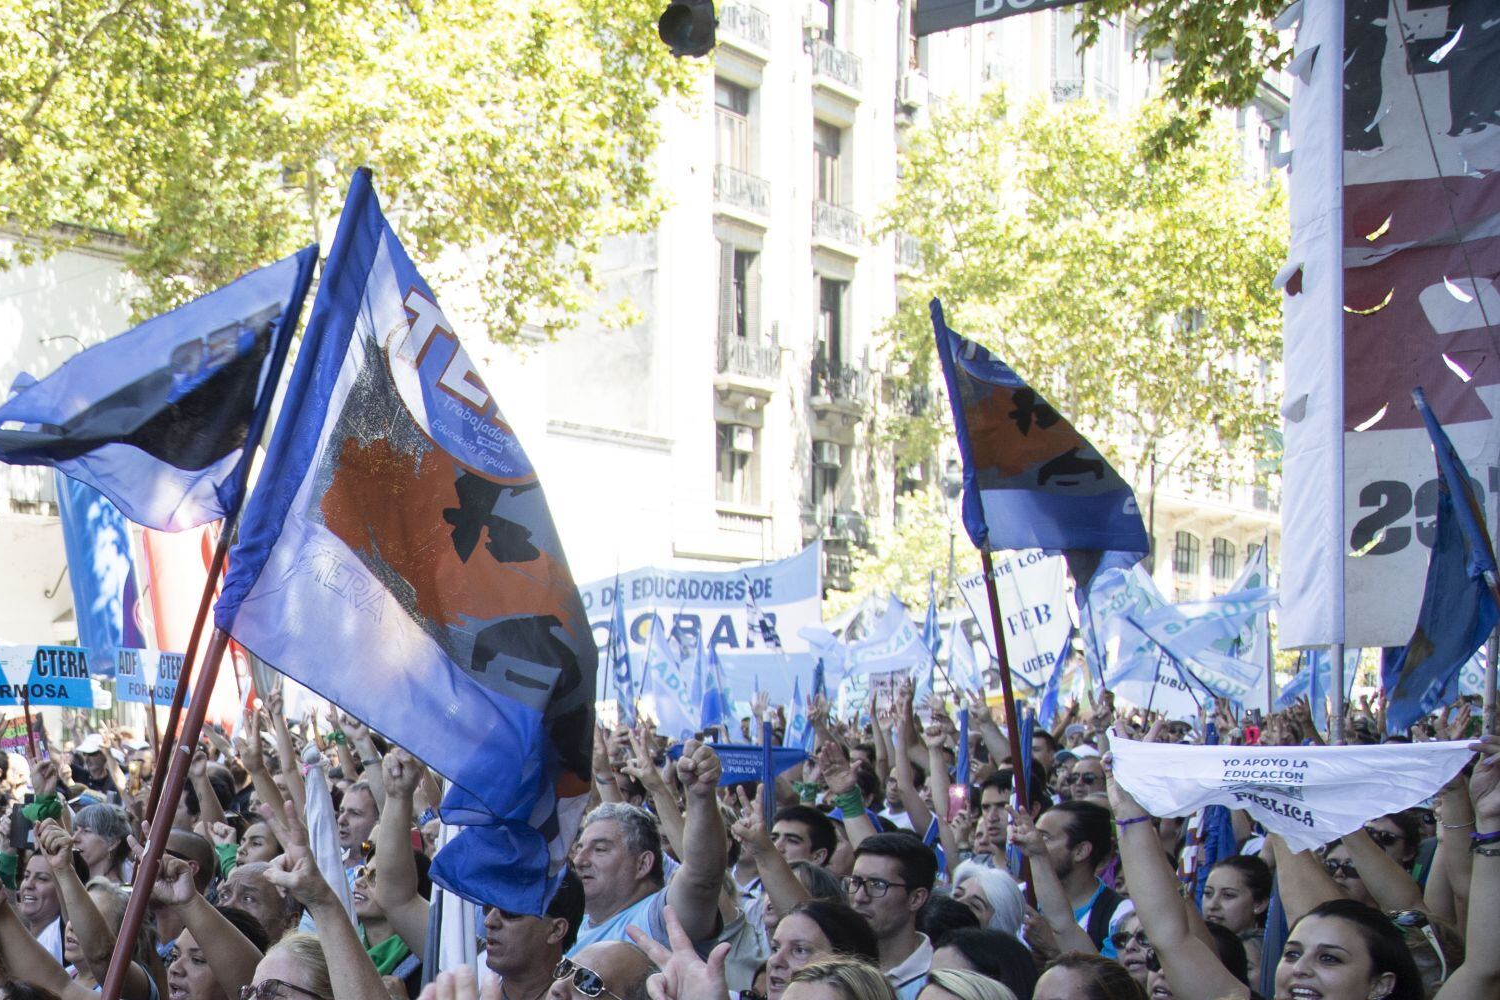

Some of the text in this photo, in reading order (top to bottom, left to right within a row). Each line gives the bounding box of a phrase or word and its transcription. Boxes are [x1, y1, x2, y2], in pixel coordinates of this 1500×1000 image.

[431, 418, 478, 455] Educación
[477, 446, 514, 475] Popular
[631, 576, 748, 601] EDUCADORES
[1006, 602, 1053, 636] FEB
[35, 649, 90, 679] CTERA
[118, 653, 138, 676] ADF
[1022, 651, 1056, 674] UDEB
[1222, 758, 1309, 769] YO APOYO LA
